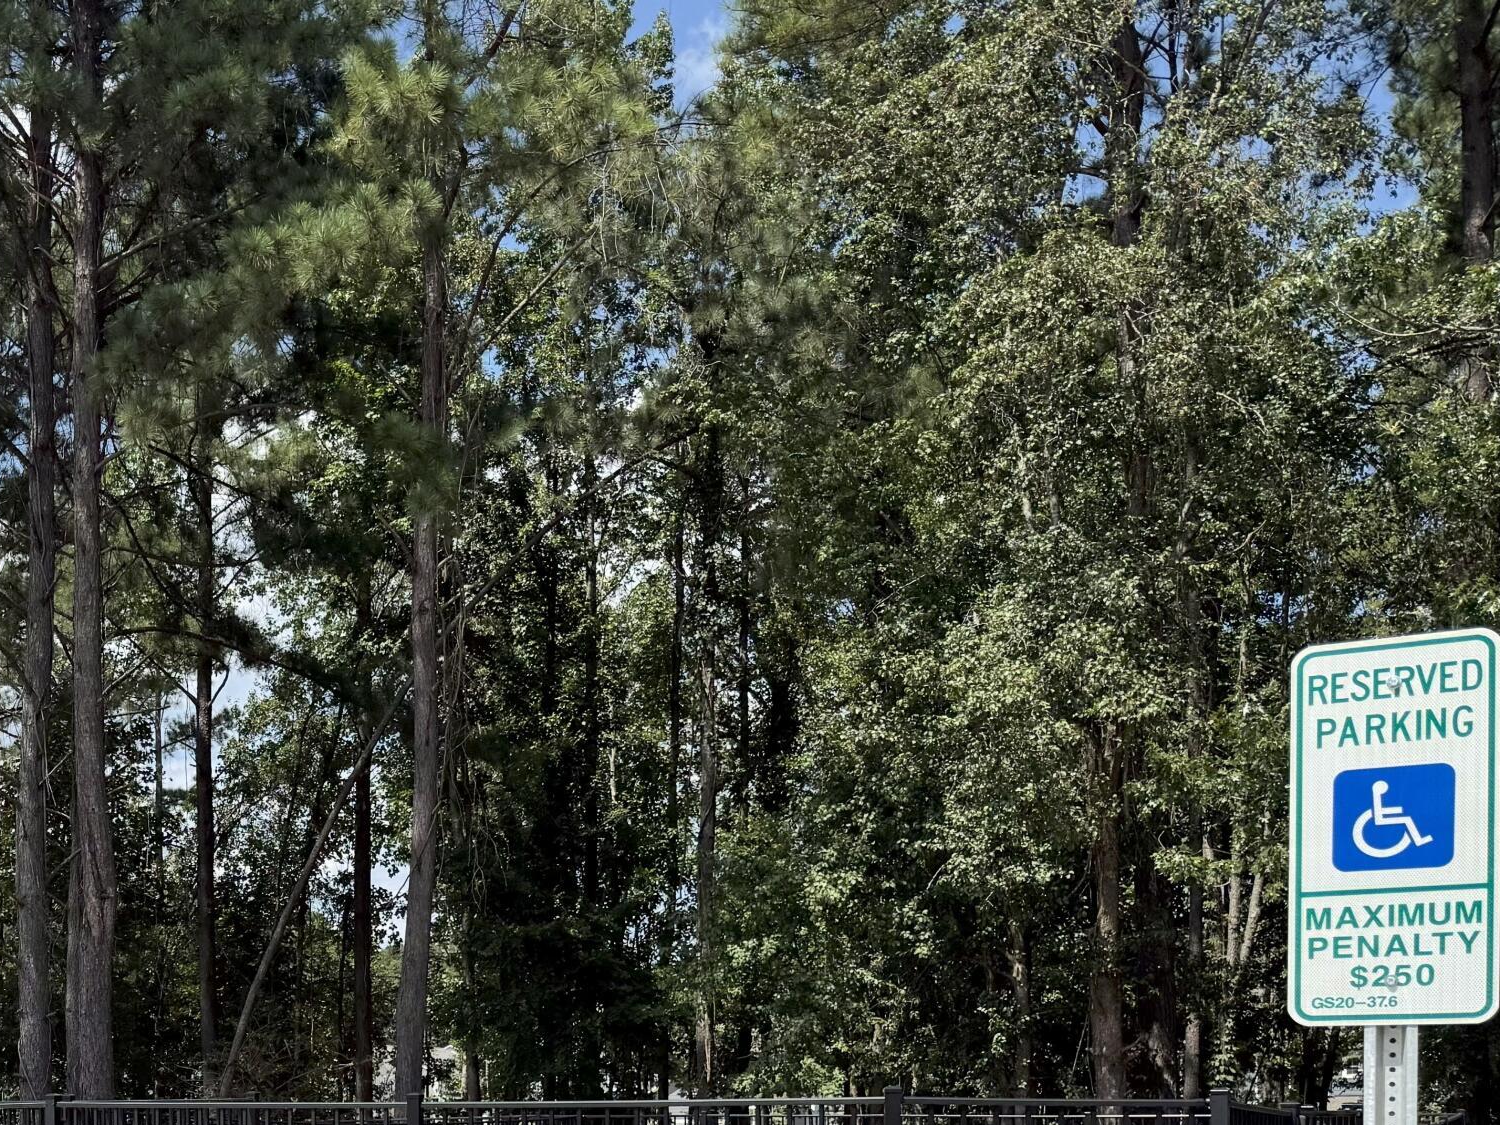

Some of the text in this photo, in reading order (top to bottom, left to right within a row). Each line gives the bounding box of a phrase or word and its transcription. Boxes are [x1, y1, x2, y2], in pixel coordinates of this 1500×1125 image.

[1308, 658, 1484, 706] RESERVED
[1316, 704, 1475, 749] PARKING
[1305, 899, 1483, 931] MAXIMUM
[1307, 930, 1481, 960] PENALTY
[1350, 963, 1435, 990] $250
